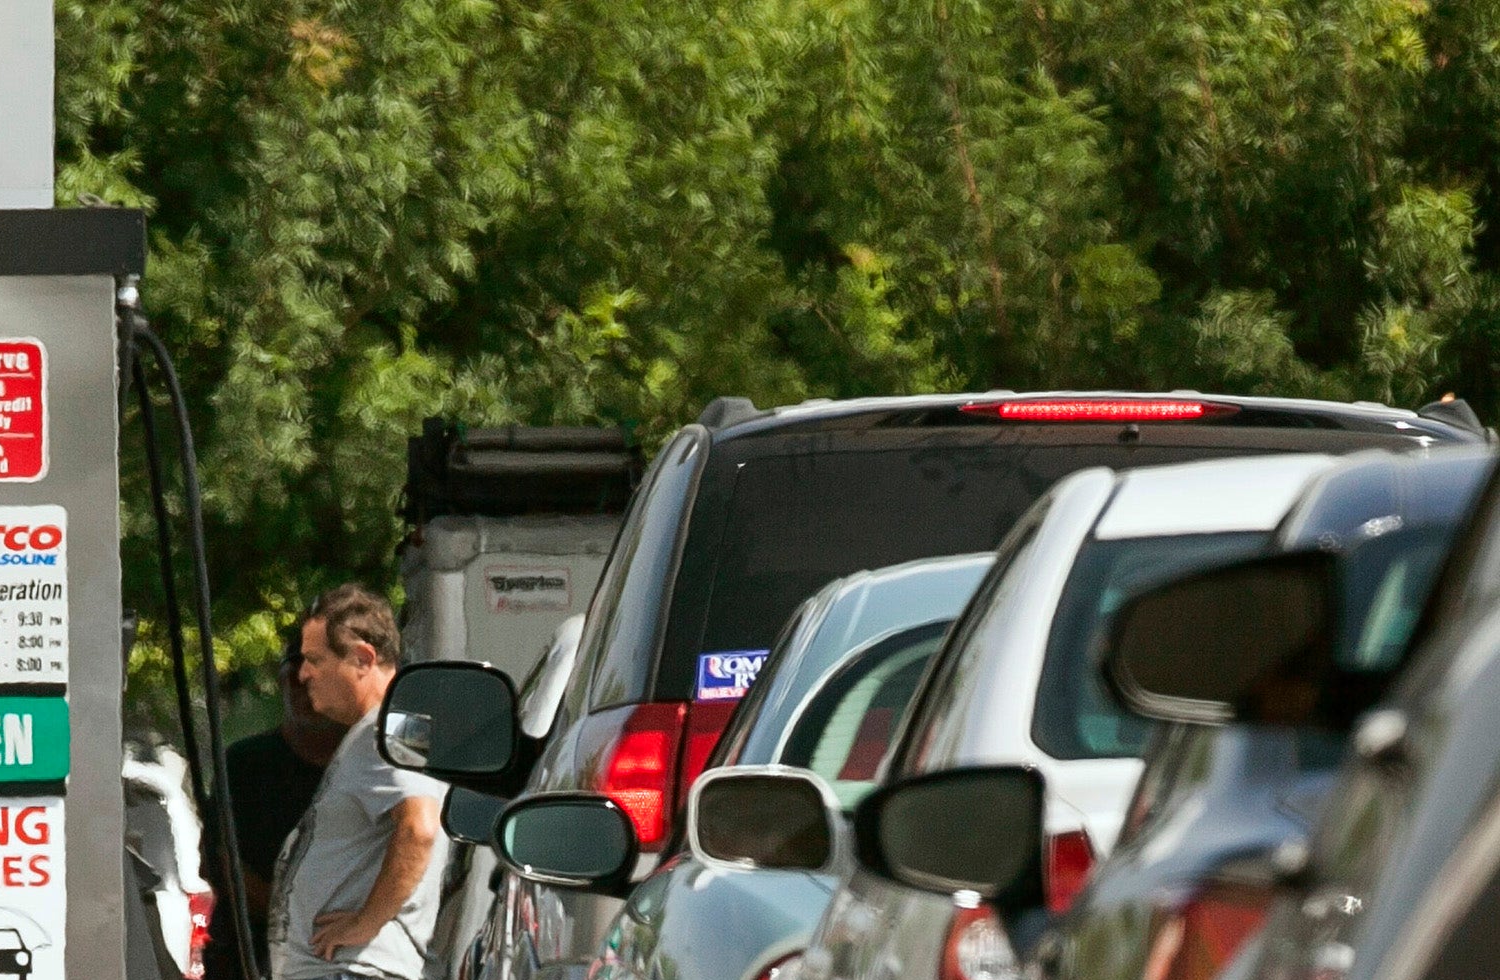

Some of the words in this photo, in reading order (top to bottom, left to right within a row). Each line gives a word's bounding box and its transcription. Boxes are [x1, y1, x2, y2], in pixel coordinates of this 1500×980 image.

[17, 612, 43, 627] 9:30
[18, 635, 43, 650] 8:00
[16, 658, 42, 673] 8:00
